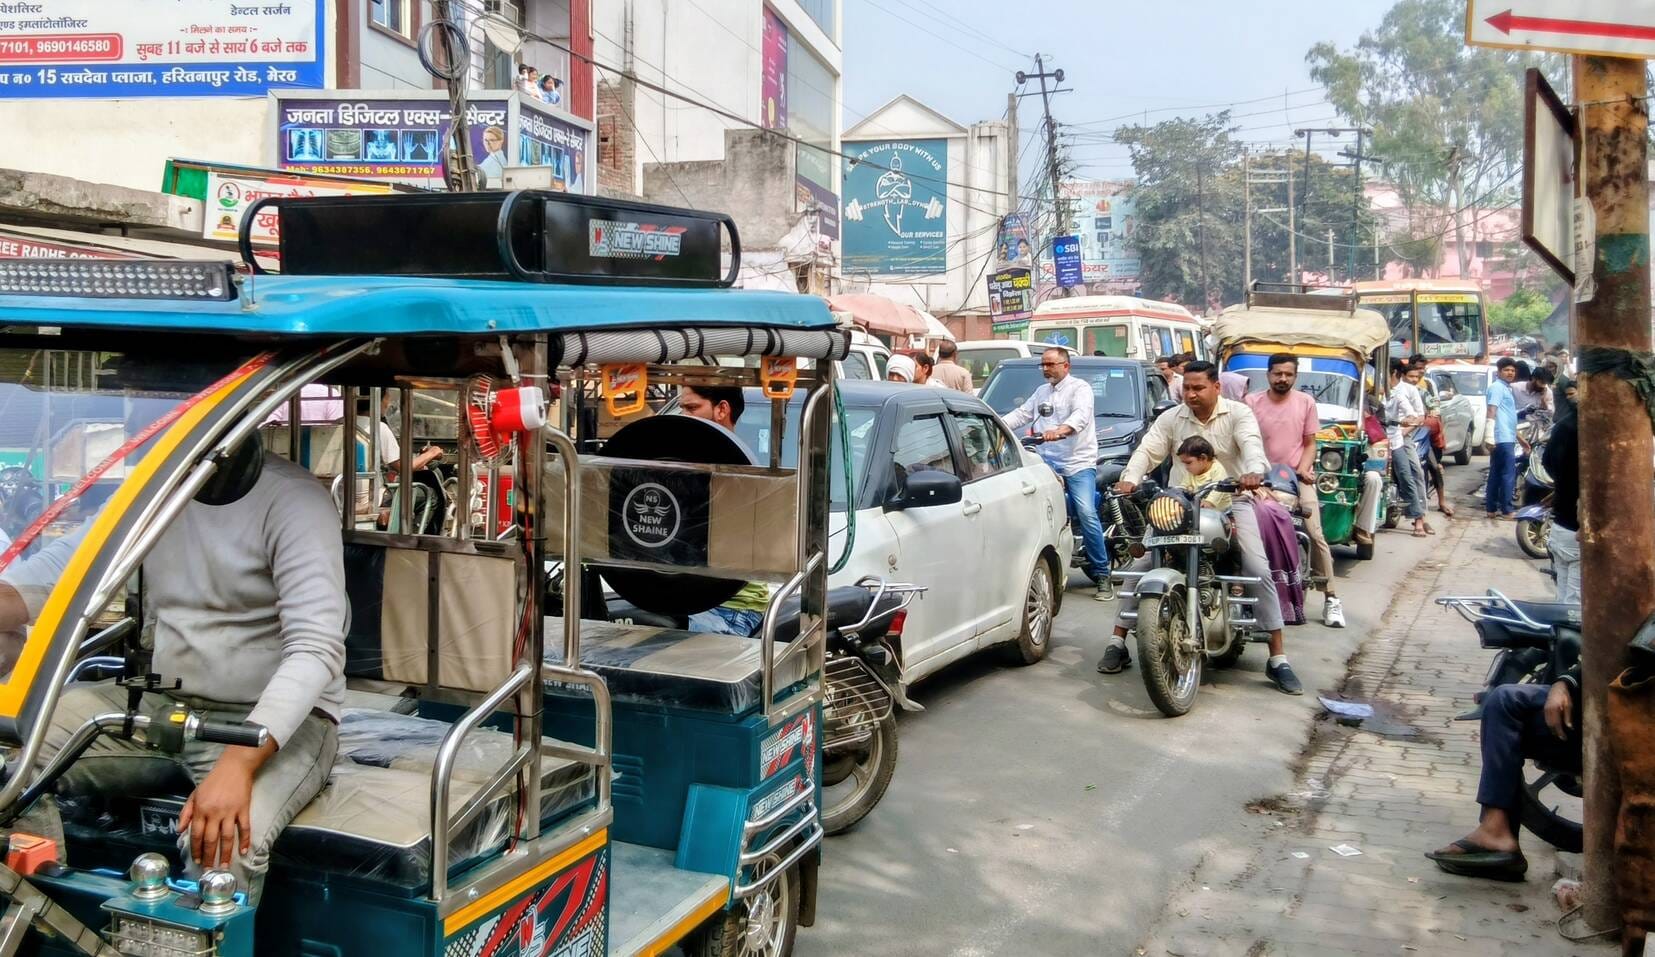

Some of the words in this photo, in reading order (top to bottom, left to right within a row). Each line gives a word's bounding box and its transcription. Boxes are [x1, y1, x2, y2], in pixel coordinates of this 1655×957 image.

[263, 4, 292, 15] सर्जन
[37, 40, 110, 53] 9690146580
[136, 43, 163, 61] सुबह
[168, 41, 180, 55] 11
[185, 39, 206, 54] बजे
[209, 39, 220, 54] से
[250, 39, 258, 54] 6
[262, 38, 282, 54] बजे
[286, 40, 308, 54] तक
[37, 69, 57, 84] 15
[60, 69, 108, 85] सचदेवा
[112, 71, 157, 85] प्लाजा,
[162, 67, 230, 87] हस्तिनापुर
[234, 66, 262, 84] रोड,
[267, 66, 297, 82] मेरठ
[286, 109, 335, 124] जनता
[338, 103, 401, 125] डिजिटल
[403, 109, 453, 125] एक्स-
[869, 142, 891, 154] YOUR
[891, 142, 915, 153] BODY
[914, 147, 933, 163] WITH
[931, 159, 943, 171] US
[614, 231, 644, 250] NEW
[645, 233, 679, 252] SHINE
[914, 230, 943, 238] SERVICES
[1064, 243, 1079, 253] SBI
[639, 514, 662, 525] NEW
[632, 524, 668, 537] SHAINE
[763, 744, 779, 765] NEW
[778, 729, 802, 753] SHINE
